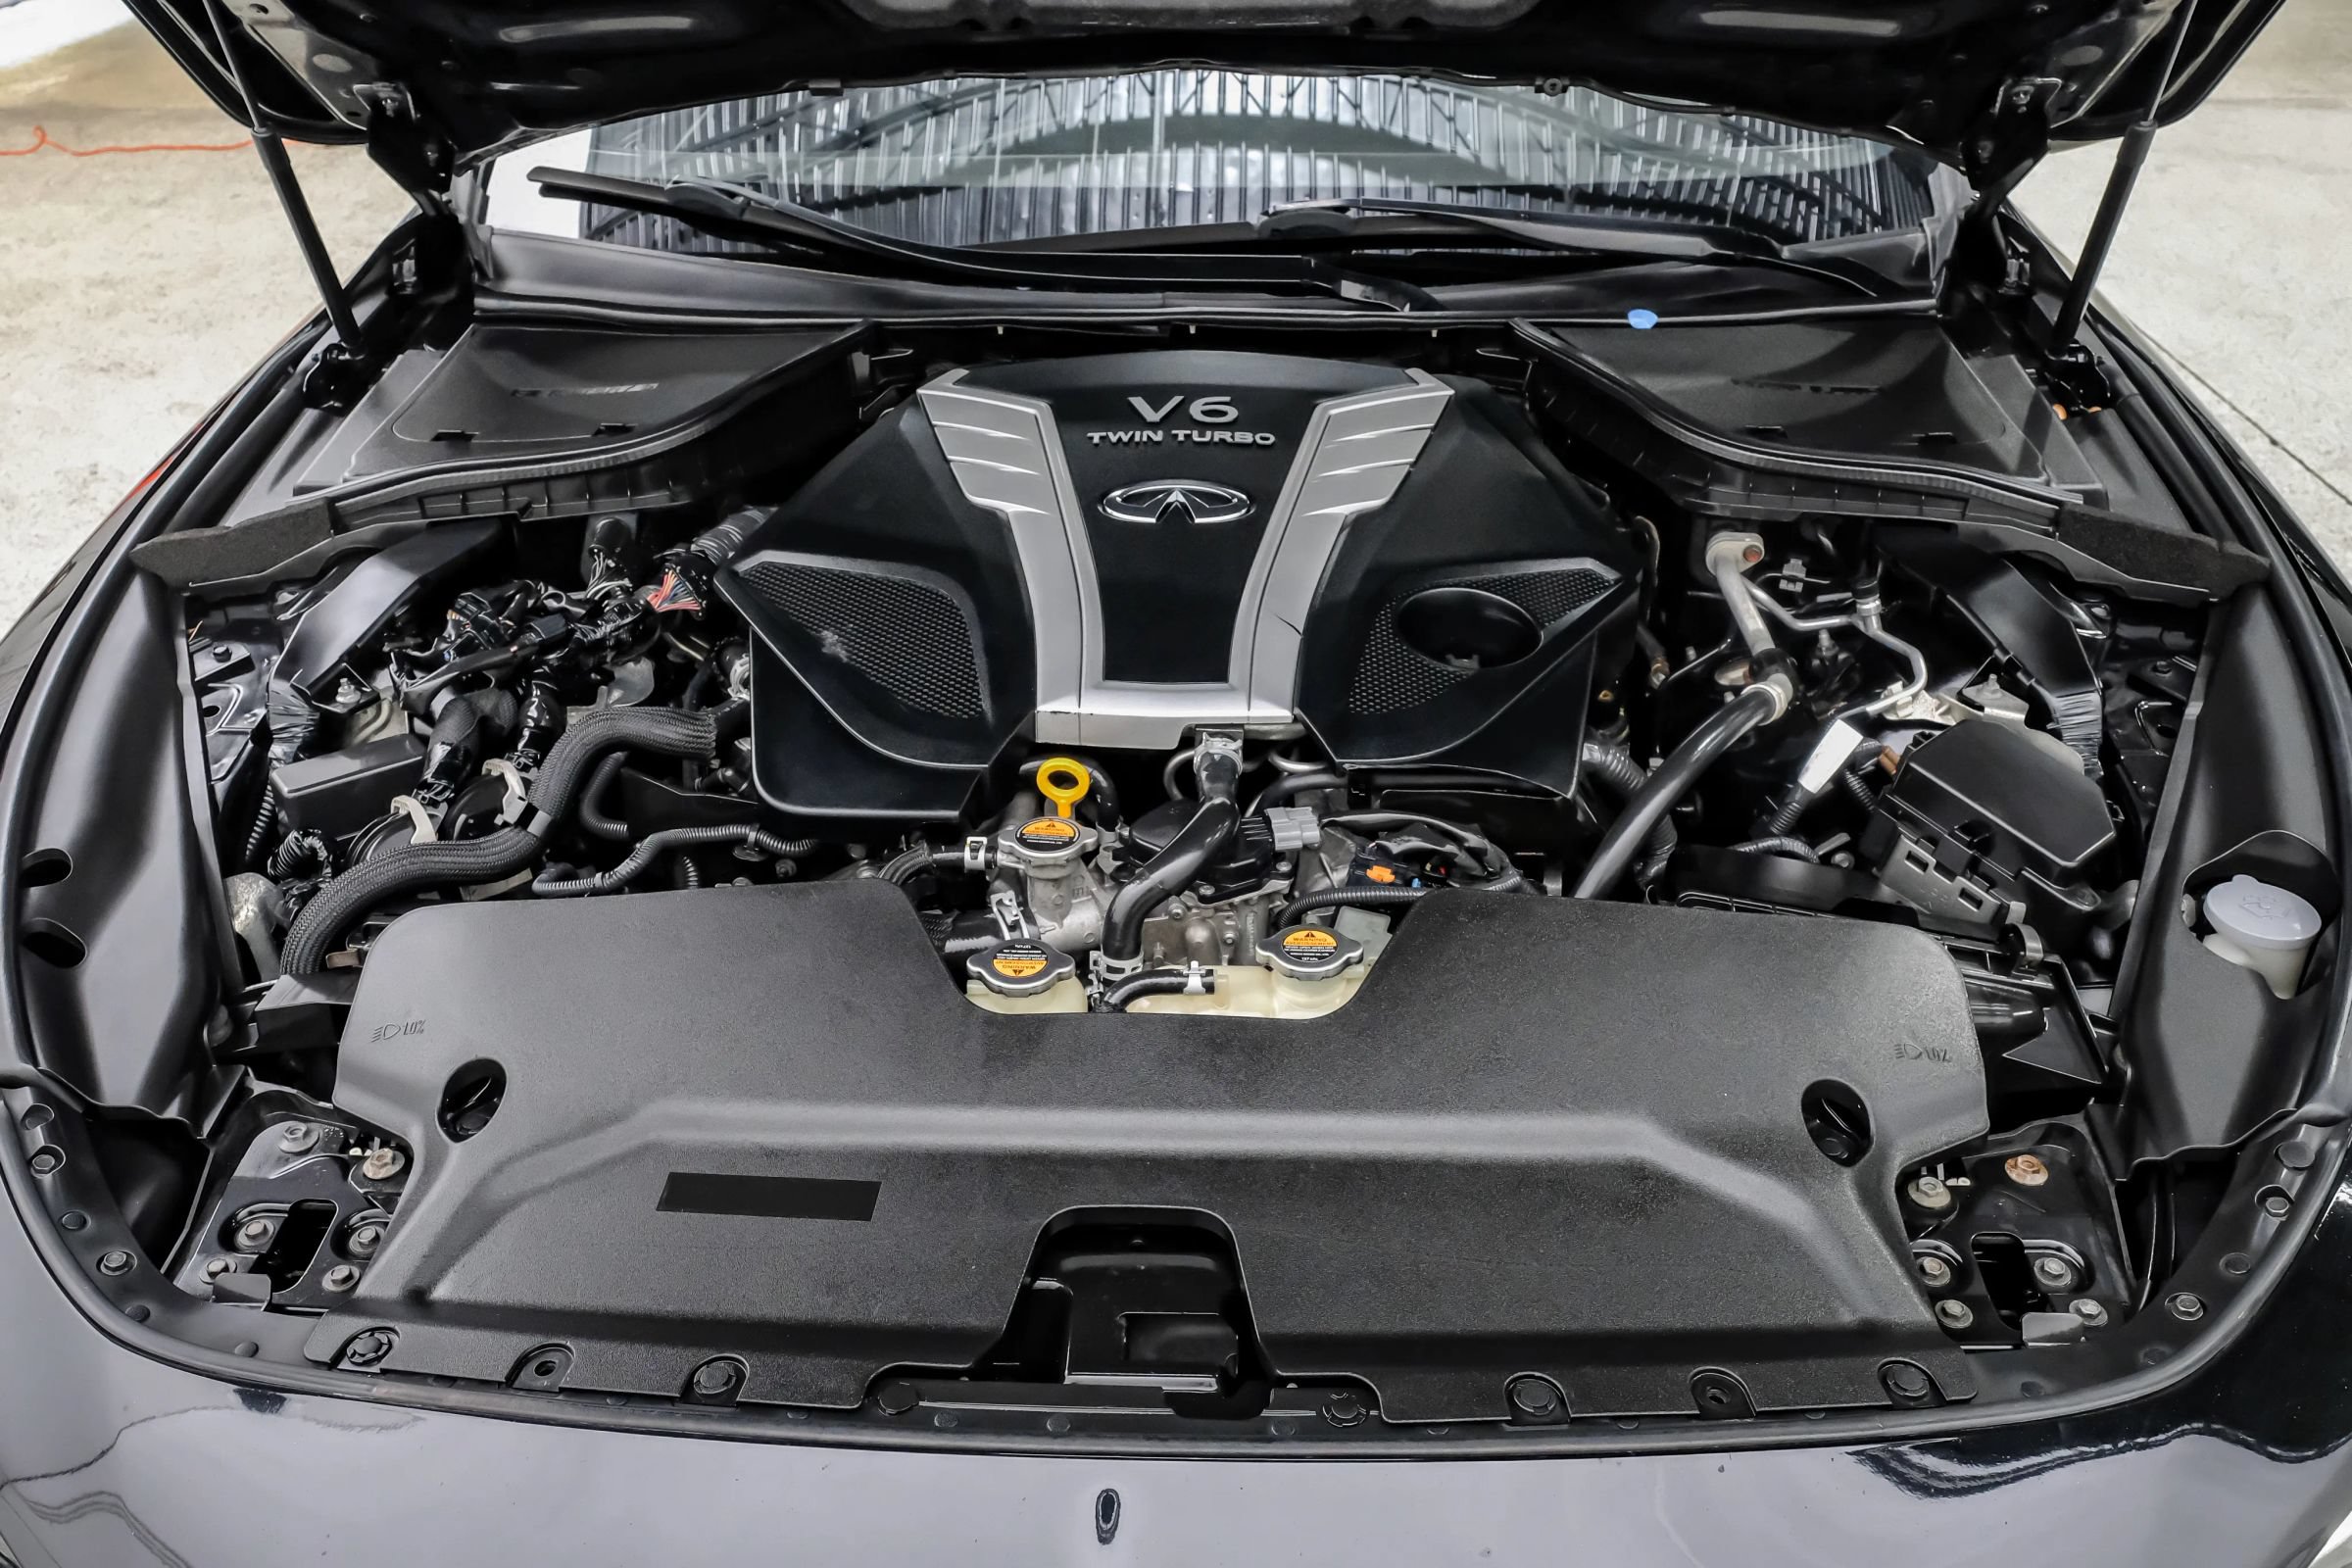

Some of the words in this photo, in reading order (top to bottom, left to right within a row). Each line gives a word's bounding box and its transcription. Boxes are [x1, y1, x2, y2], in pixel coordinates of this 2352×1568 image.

[1127, 396, 1239, 423] V6
[1087, 430, 1164, 444] TWIN
[1171, 429, 1276, 445] TURBO
